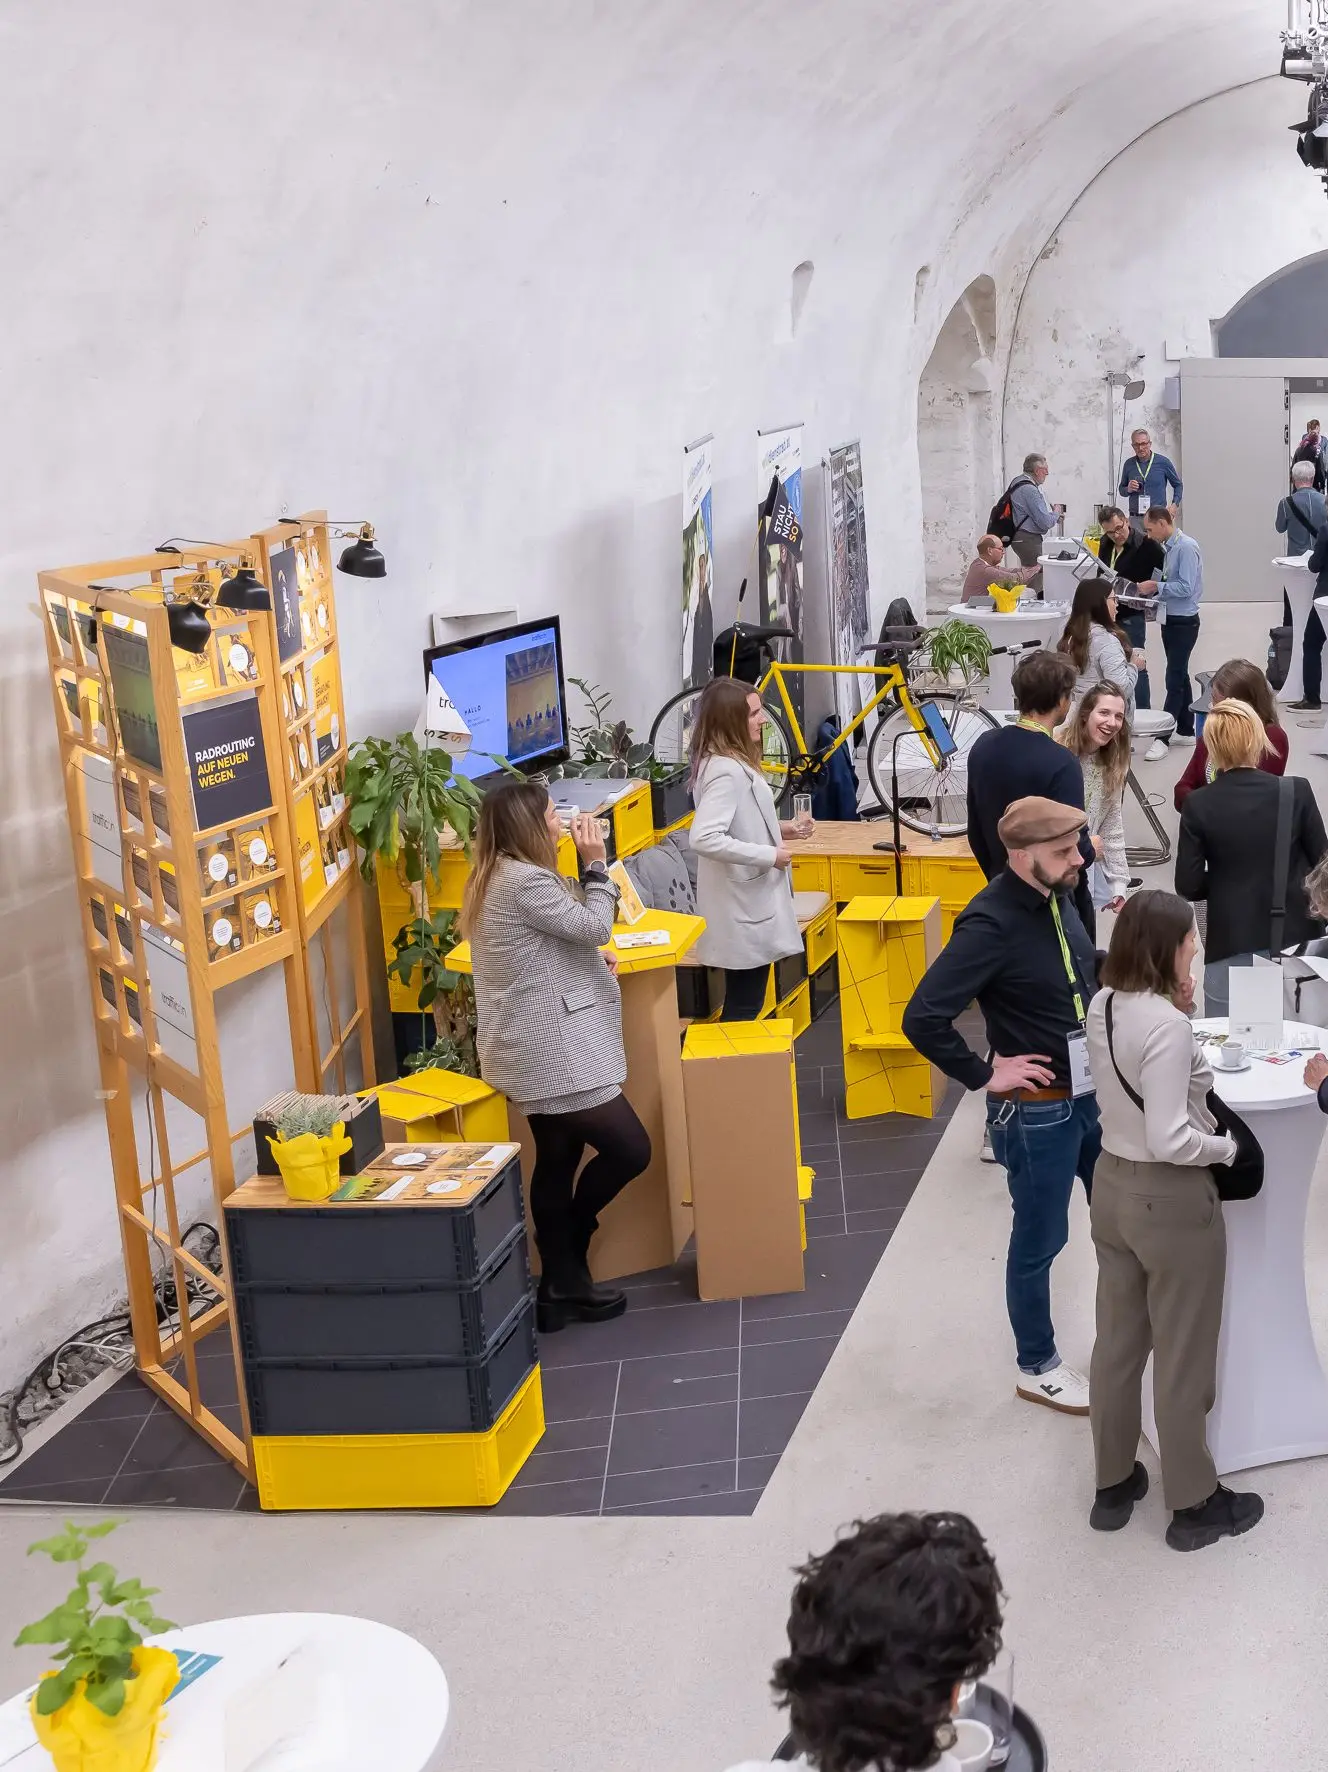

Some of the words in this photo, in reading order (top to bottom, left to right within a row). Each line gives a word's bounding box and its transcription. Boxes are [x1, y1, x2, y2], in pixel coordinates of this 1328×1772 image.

[774, 504, 787, 535] STAU
[781, 503, 794, 538] NICHT
[789, 526, 799, 543] SO
[195, 736, 256, 763] RADROUTING
[197, 761, 216, 776] AUF
[217, 751, 249, 770] NEUEN
[198, 768, 236, 789] WEGEN.
